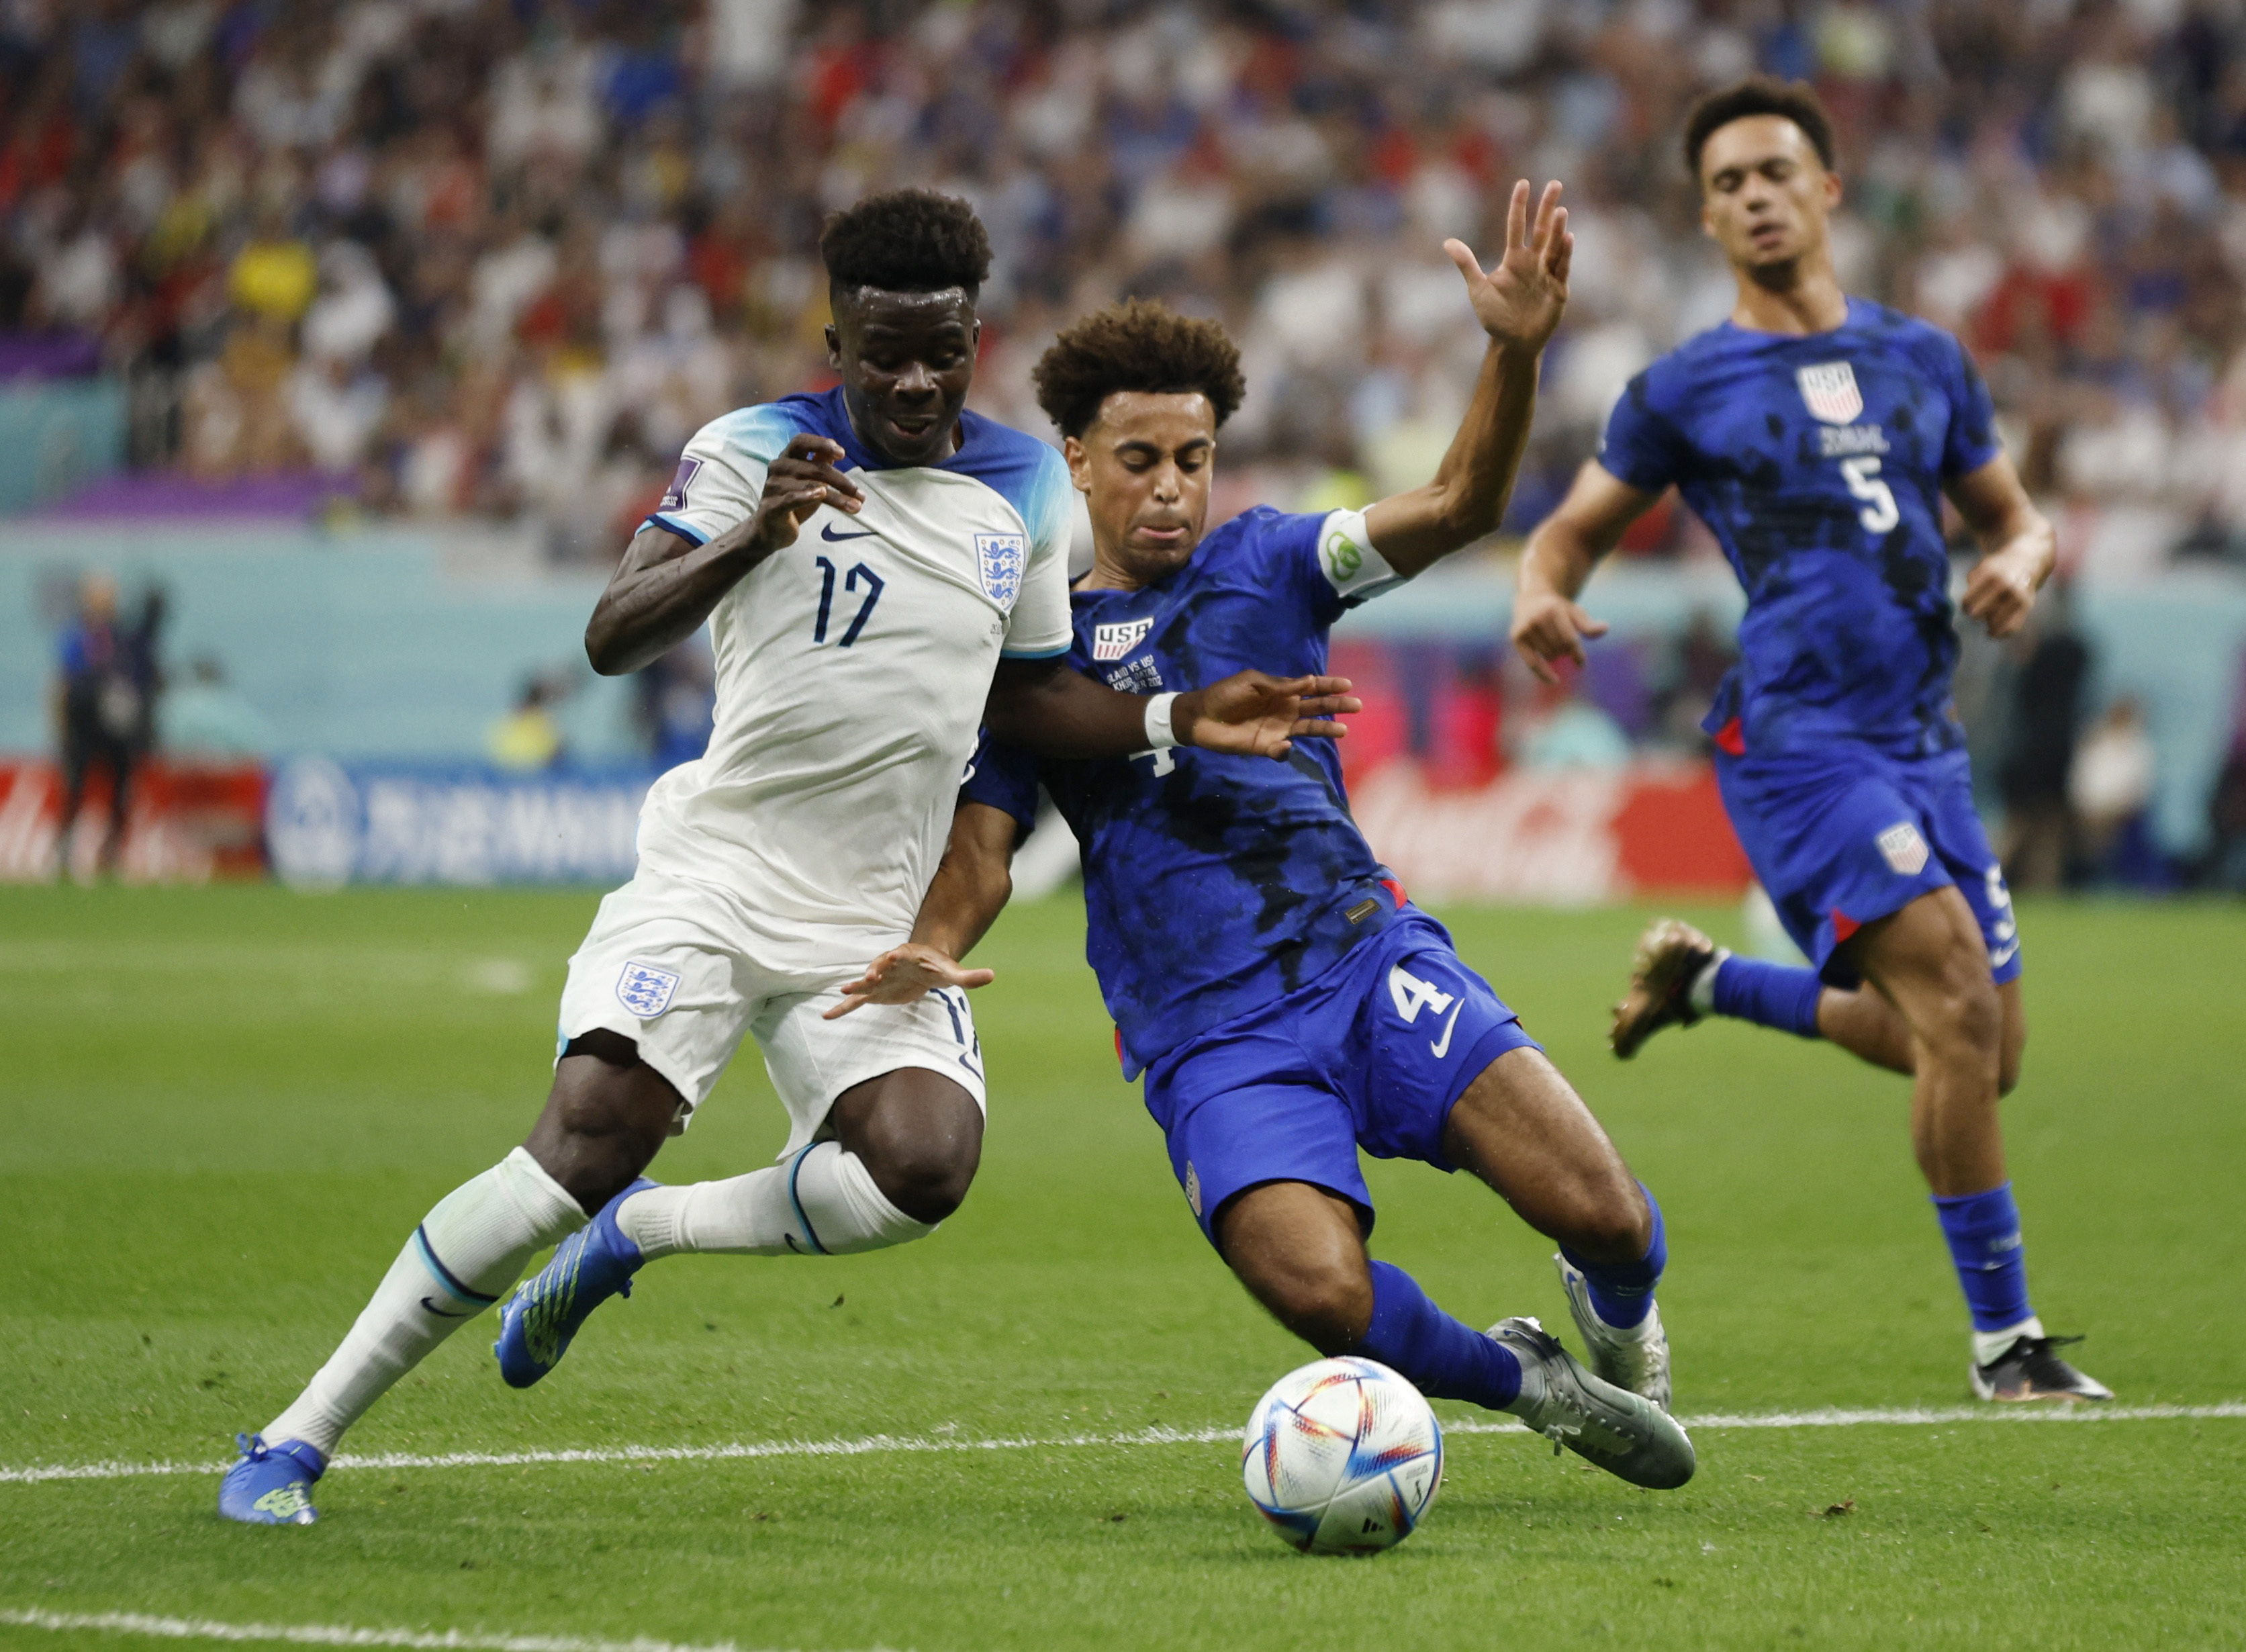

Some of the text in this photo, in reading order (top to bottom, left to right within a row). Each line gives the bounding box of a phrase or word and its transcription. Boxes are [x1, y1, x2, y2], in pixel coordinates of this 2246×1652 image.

[1842, 457, 1900, 533] 5
[814, 555, 885, 647] 17
[1389, 964, 1454, 1023] 4
